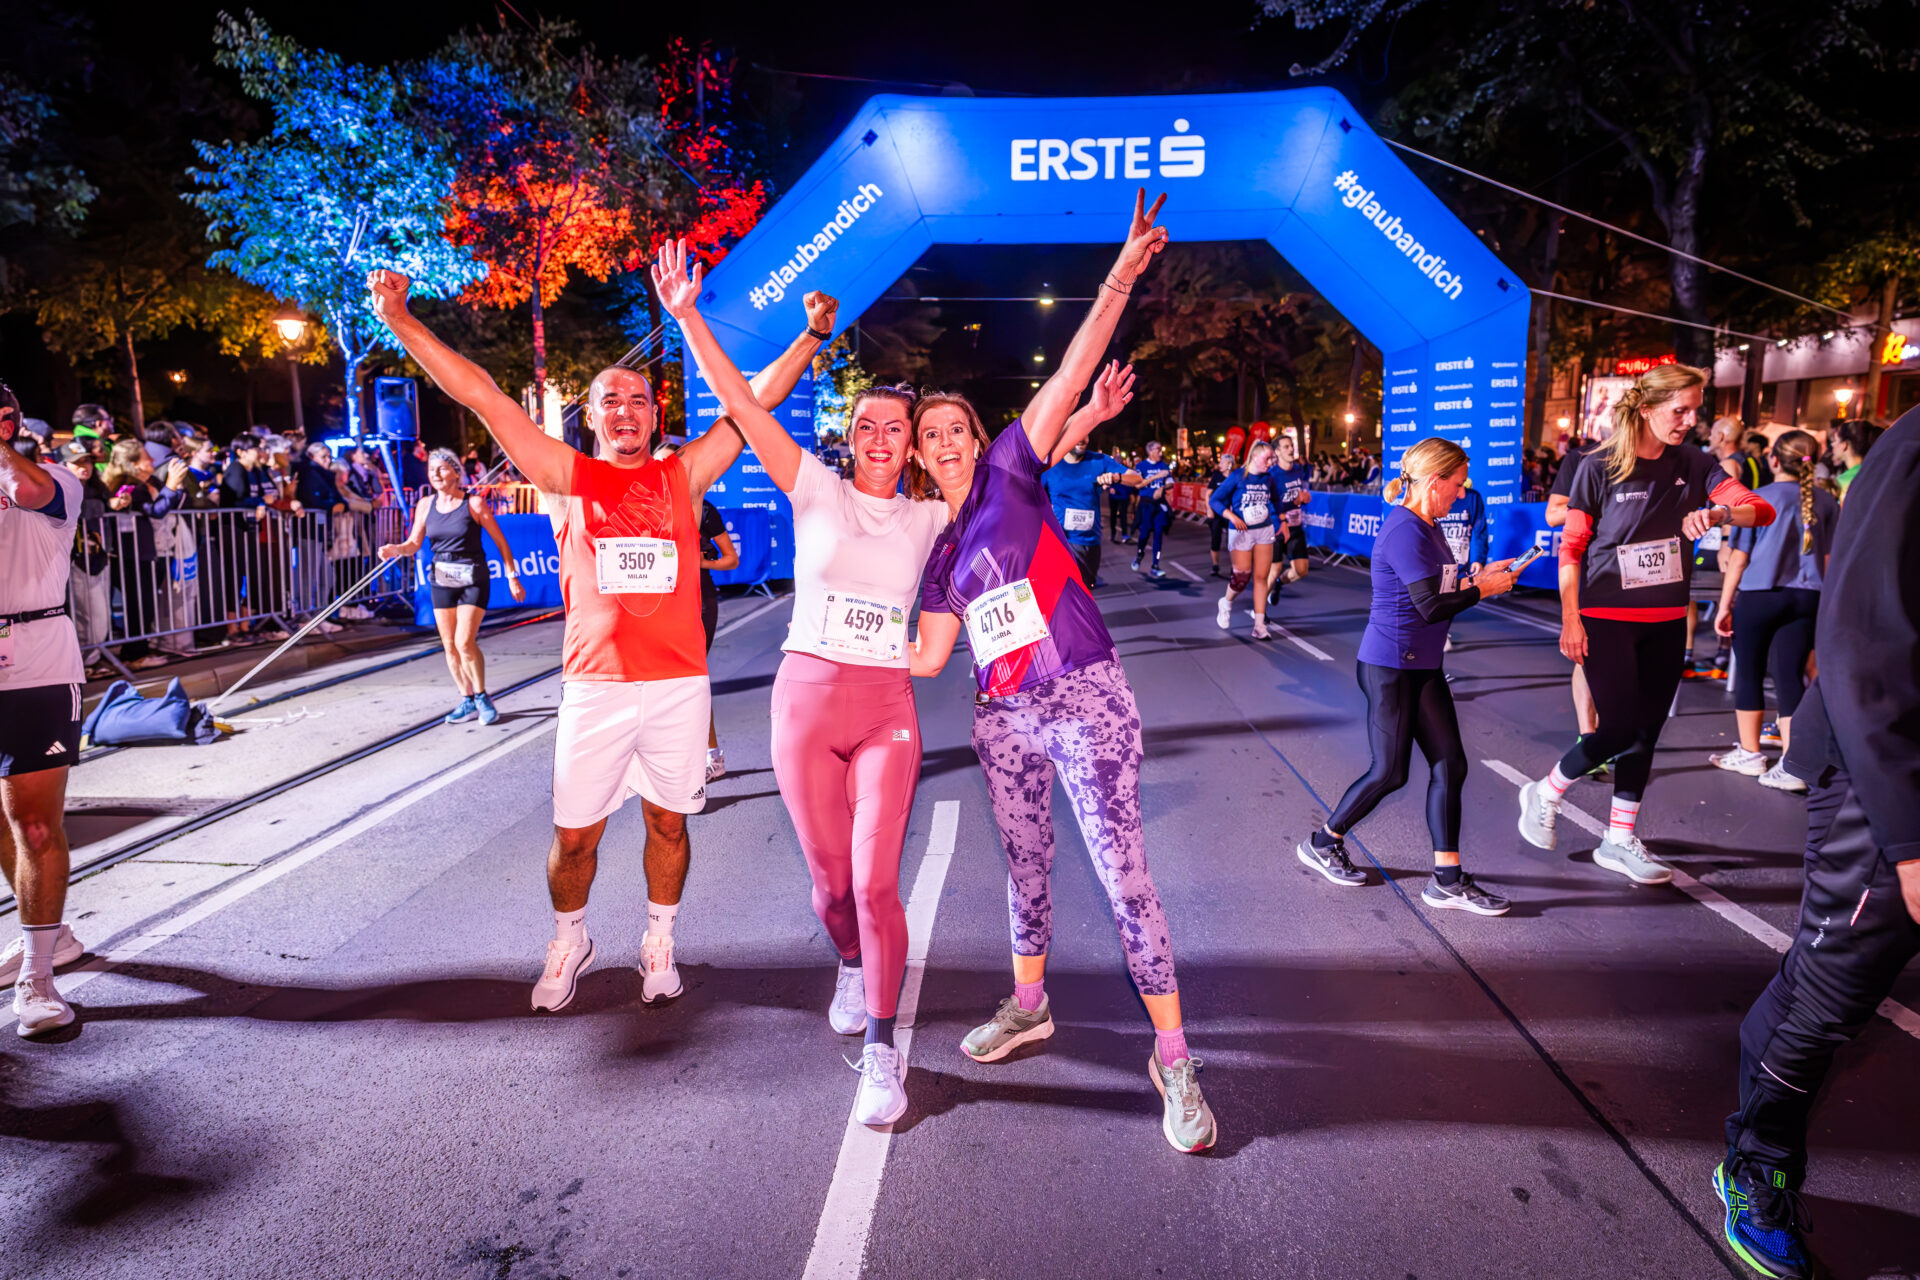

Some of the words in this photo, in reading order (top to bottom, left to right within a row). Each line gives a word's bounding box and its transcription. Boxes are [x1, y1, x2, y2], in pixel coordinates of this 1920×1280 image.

[1011, 136, 1151, 181] ERSTE
[1333, 170, 1463, 300] #glaubandich
[749, 183, 883, 310] #glaubandich
[1435, 361, 1464, 371] ERSTE
[1434, 401, 1463, 411] ERSTE
[1348, 513, 1381, 537] ERSTE
[618, 552, 656, 570] 3509
[1637, 552, 1666, 569] 4329
[844, 608, 884, 633] 4599
[980, 602, 1015, 634] 4716
[854, 633, 870, 642] ANA
[991, 629, 1012, 642] MARIA
